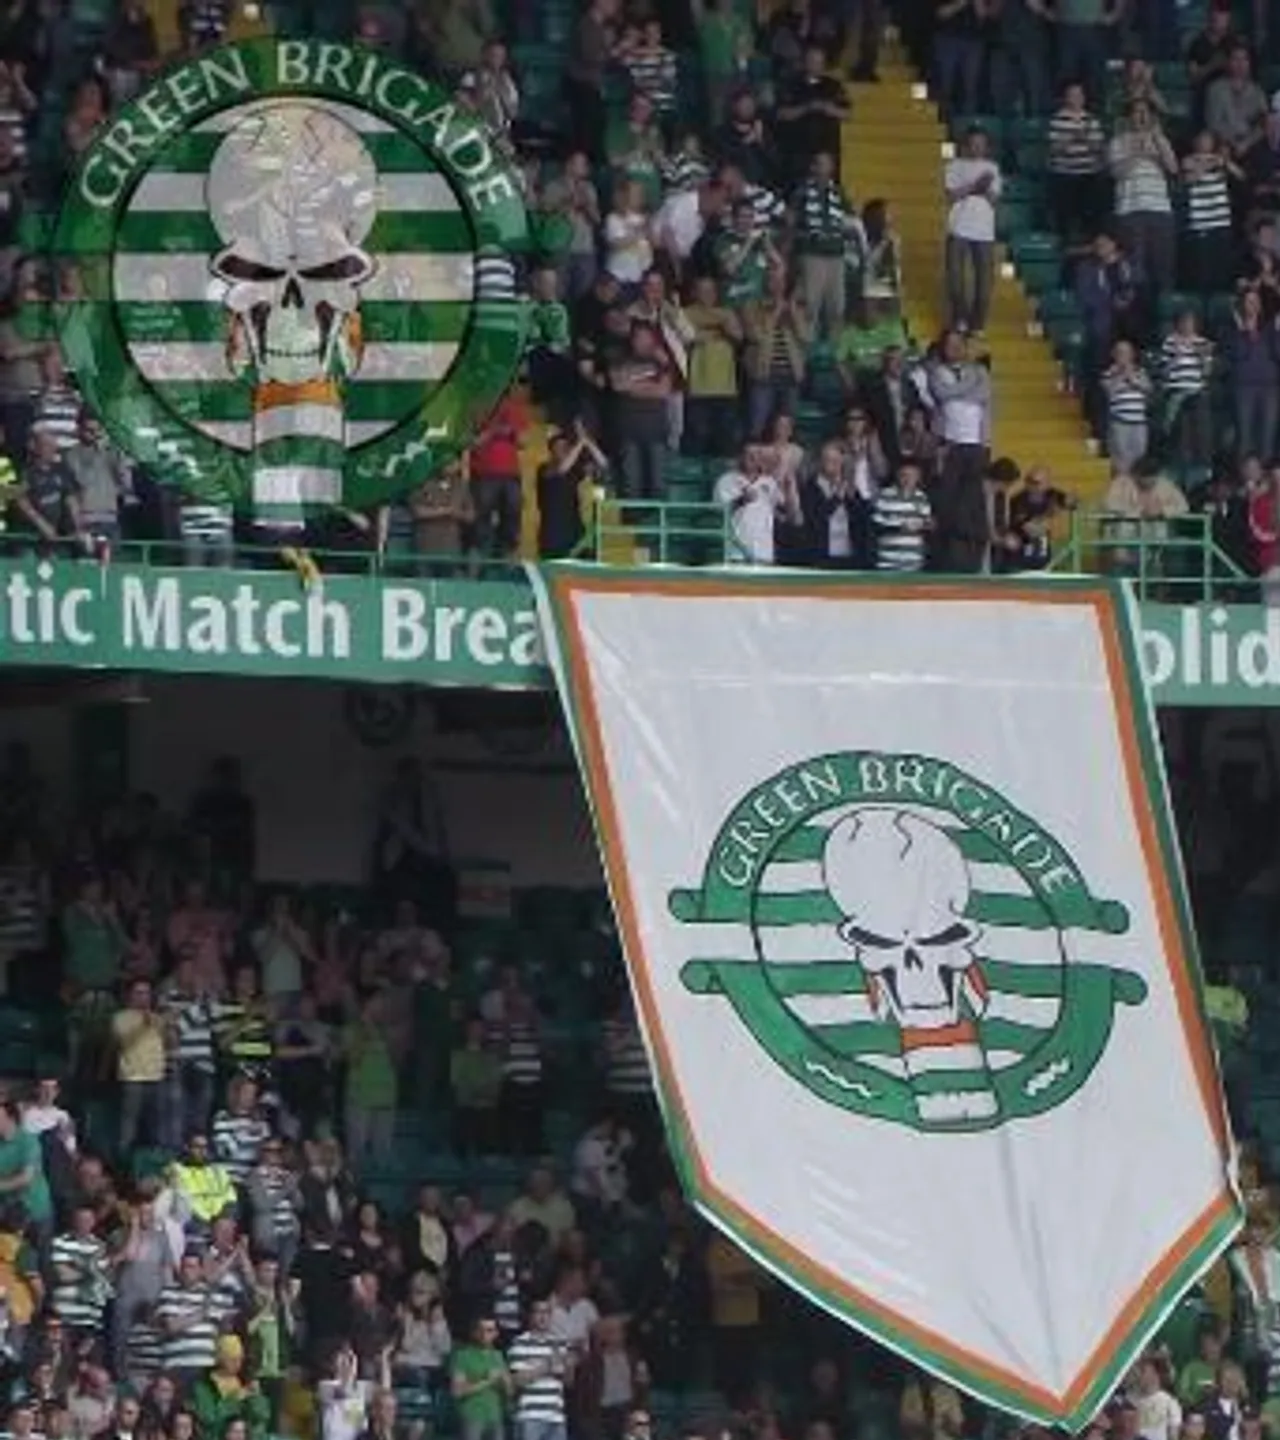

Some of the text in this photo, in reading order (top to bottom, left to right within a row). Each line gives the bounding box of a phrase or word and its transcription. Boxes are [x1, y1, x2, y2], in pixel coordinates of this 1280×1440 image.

[121, 578, 351, 659] Match
[719, 758, 1077, 896] GREEN BRIGADE
